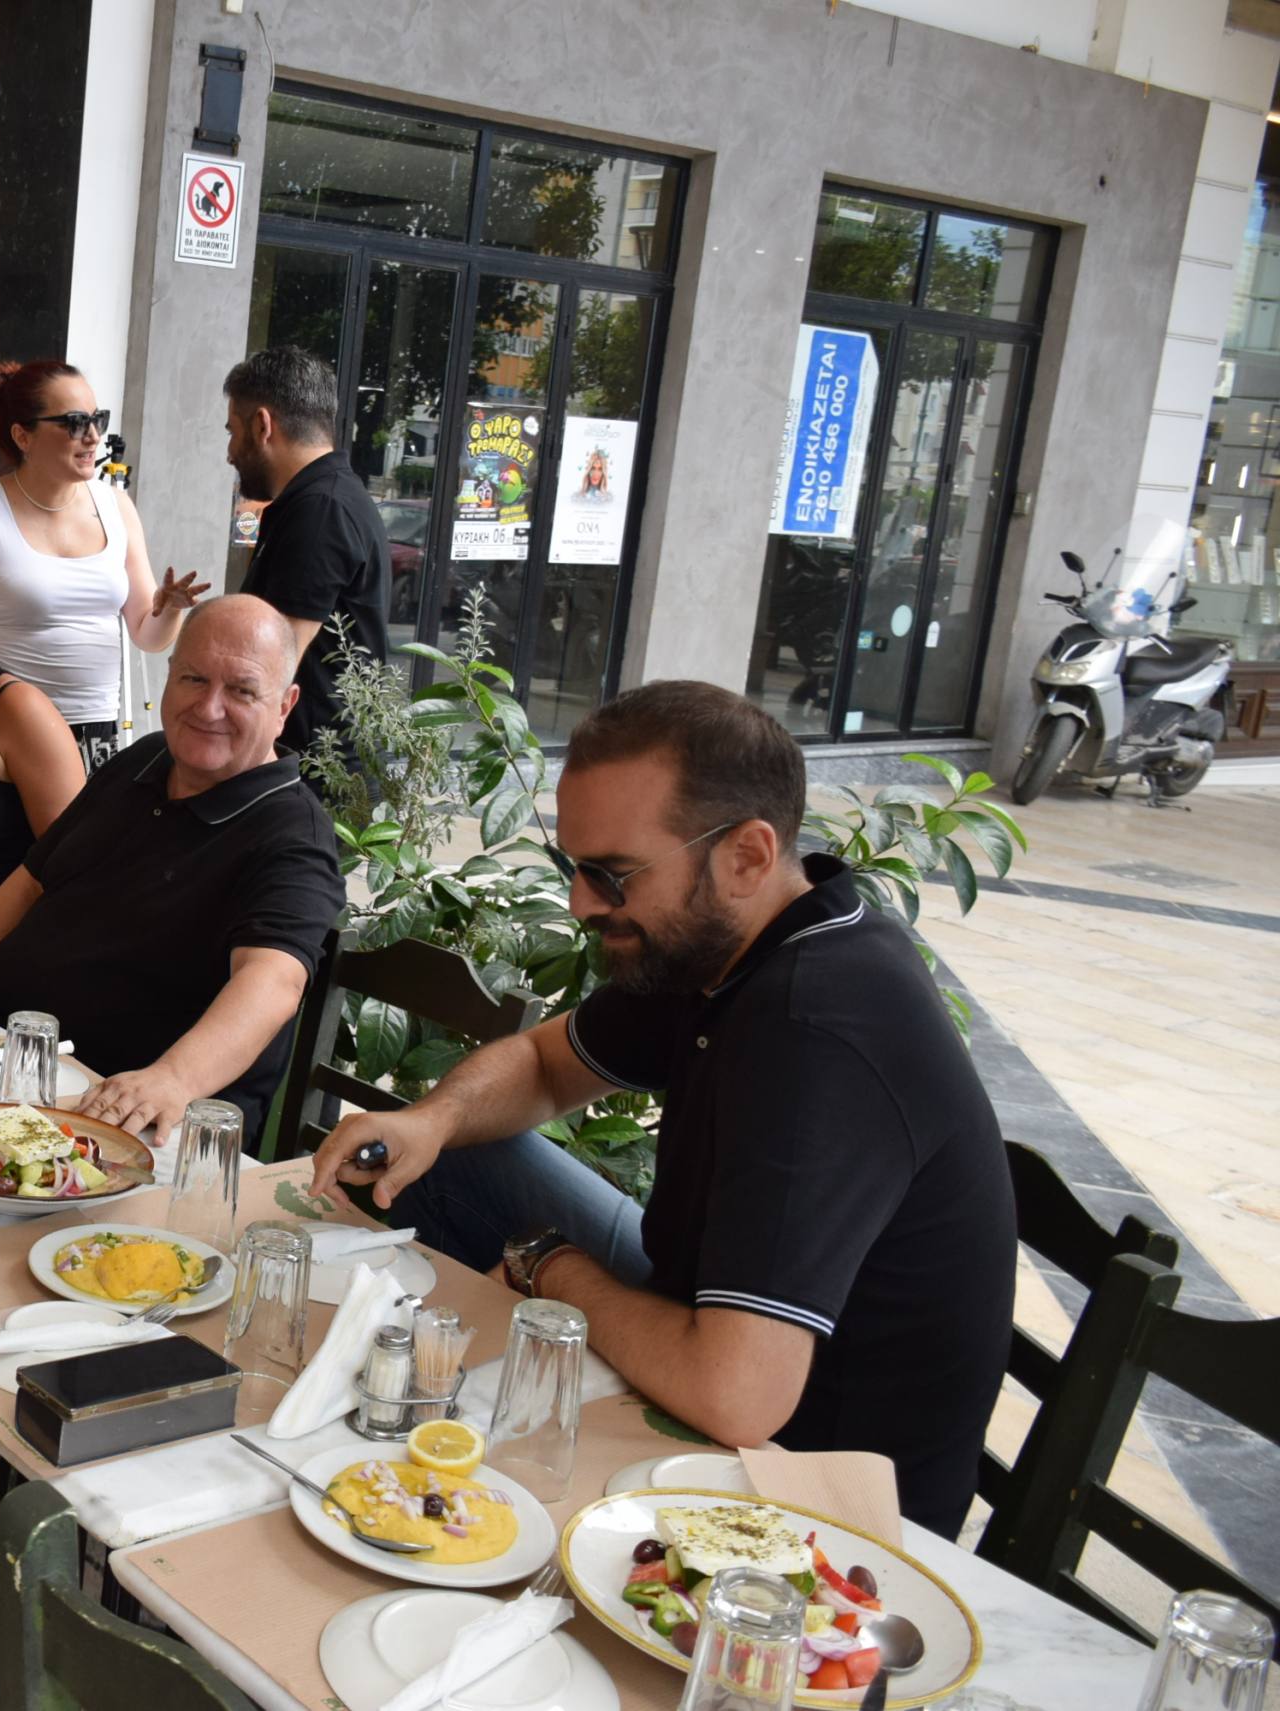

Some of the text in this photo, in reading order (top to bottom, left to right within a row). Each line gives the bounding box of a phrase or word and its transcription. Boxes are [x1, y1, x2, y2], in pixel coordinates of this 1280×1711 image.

[194, 229, 230, 241] ΠΑΡΑΒΑΤΕΣ
[795, 343, 837, 522] ΕΝΟΙΚΙΑΖΕΤΑΙ
[813, 375, 848, 522] 2610 456 000
[454, 531, 490, 544] ΚΥΡΙΑΚΗ
